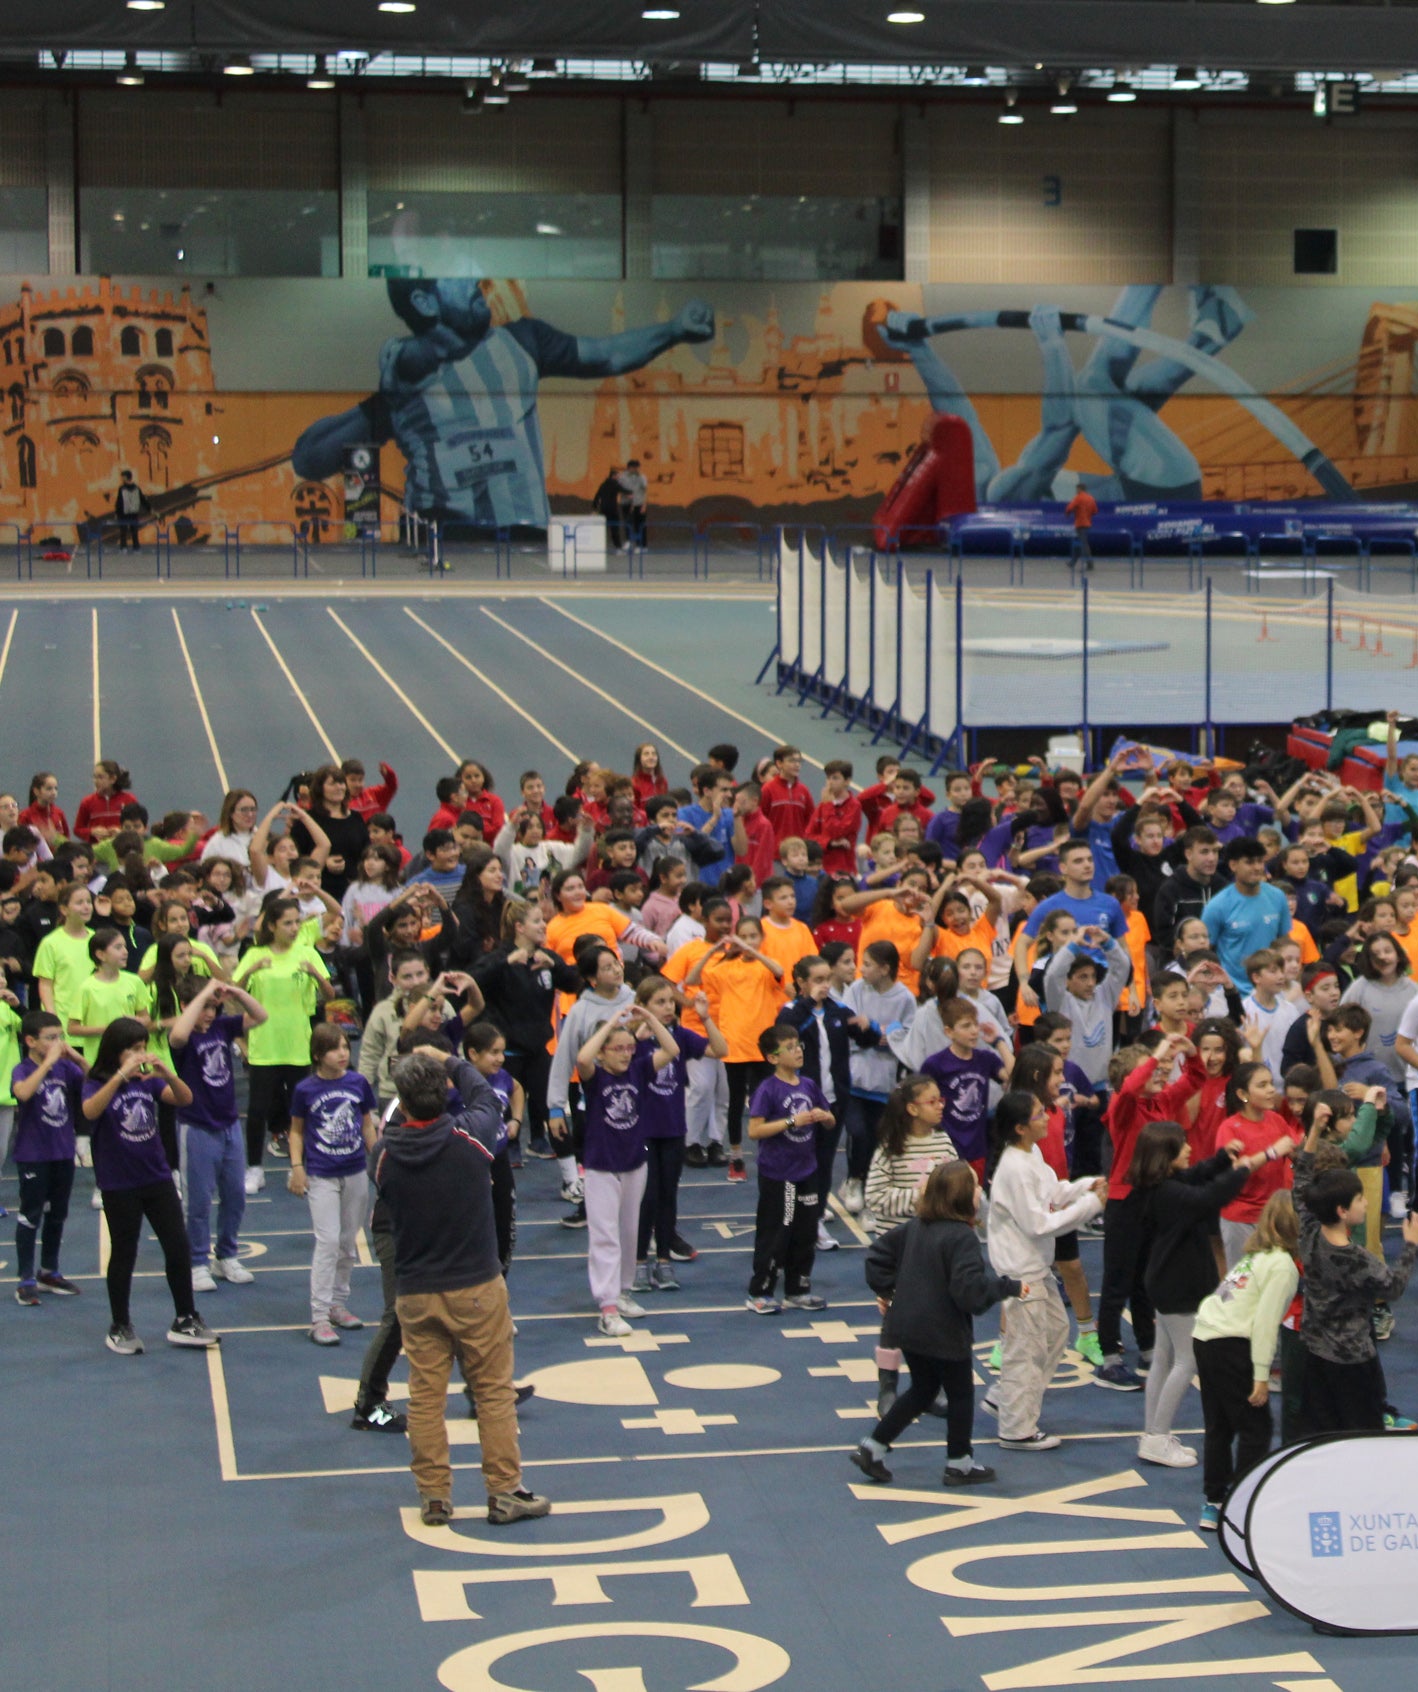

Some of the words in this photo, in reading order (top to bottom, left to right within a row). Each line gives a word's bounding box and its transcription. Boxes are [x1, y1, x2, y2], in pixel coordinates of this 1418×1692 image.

[1331, 84, 1355, 113] E
[468, 443, 493, 462] 54
[1350, 1535, 1377, 1552] DE
[848, 1469, 1344, 1692] XUN
